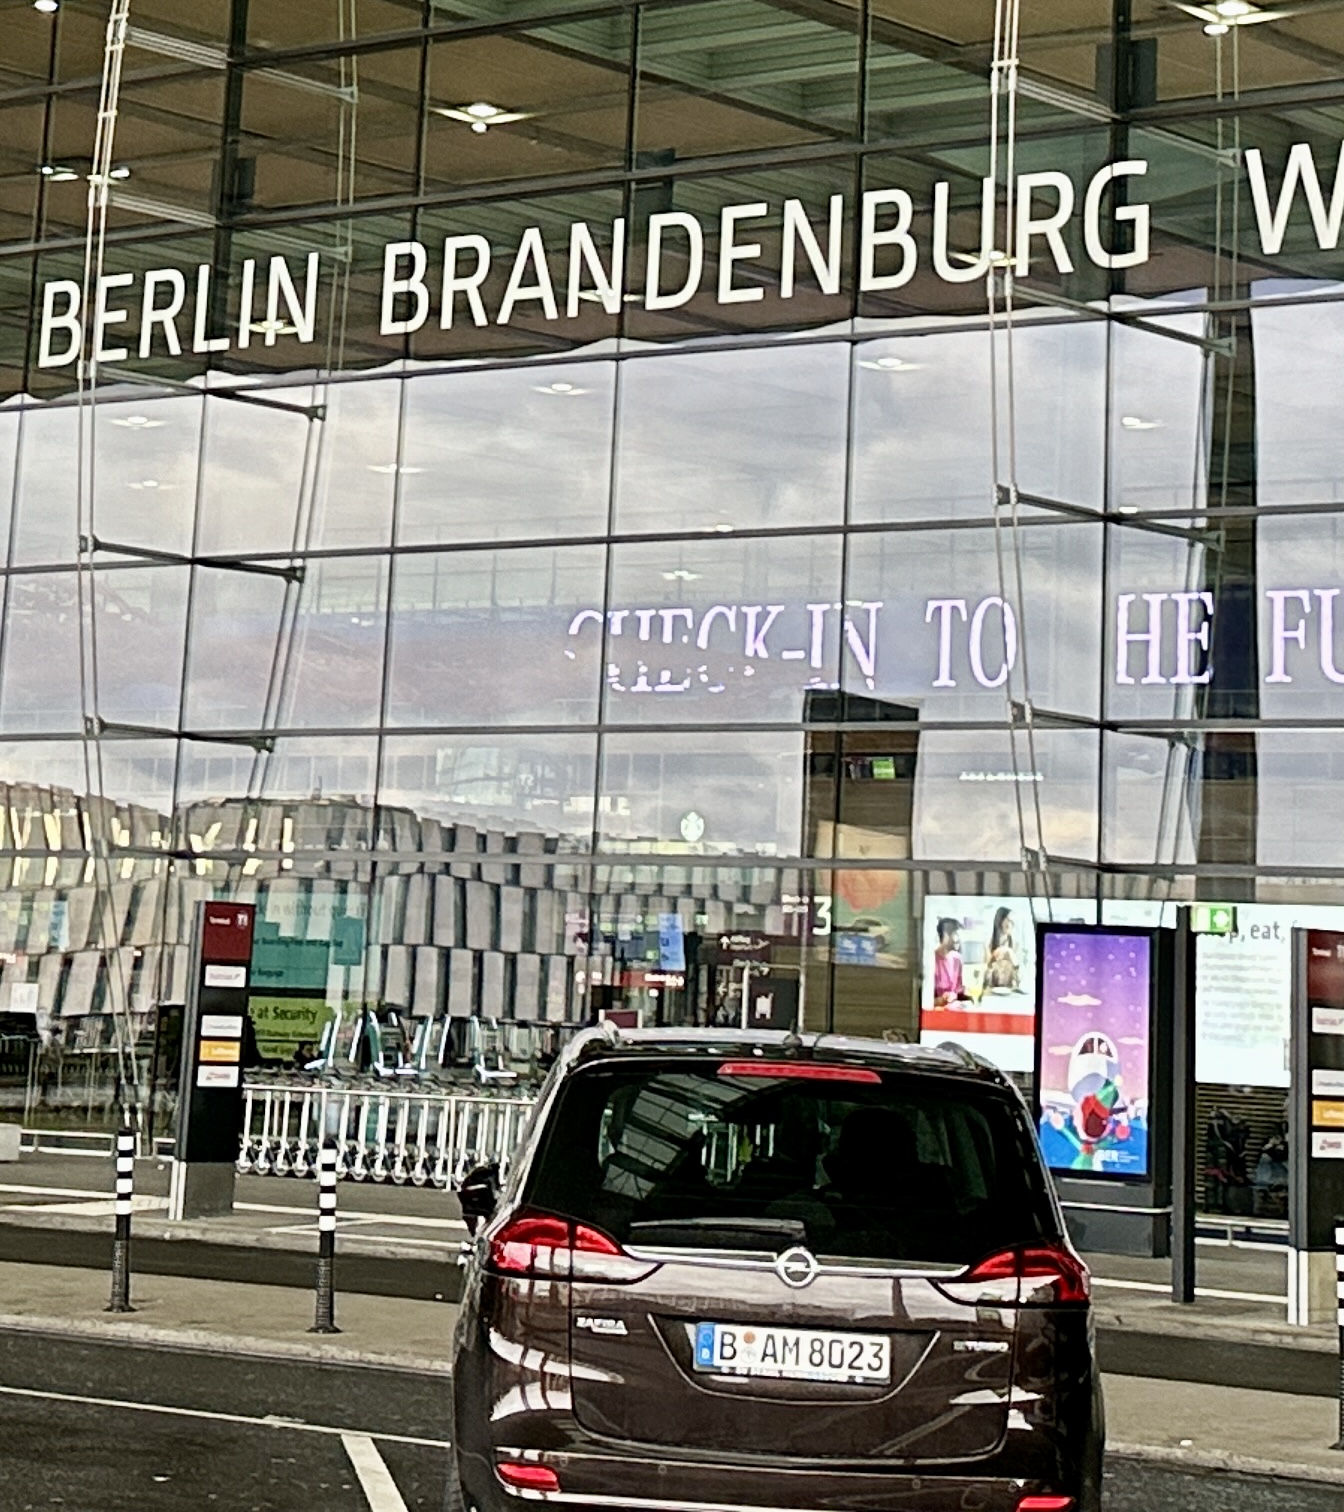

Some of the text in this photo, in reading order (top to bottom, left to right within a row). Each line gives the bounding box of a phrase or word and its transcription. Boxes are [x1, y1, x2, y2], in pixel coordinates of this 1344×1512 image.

[38, 252, 321, 370] BERLIN
[379, 160, 1152, 337] BRANDENBURG
[924, 596, 1017, 688] TO
[1115, 591, 1215, 685] HE
[812, 895, 832, 936] 3
[272, 1005, 319, 1025] Security
[719, 1330, 737, 1361] B
[760, 1333, 801, 1366] AM
[808, 1337, 884, 1372] 8023
